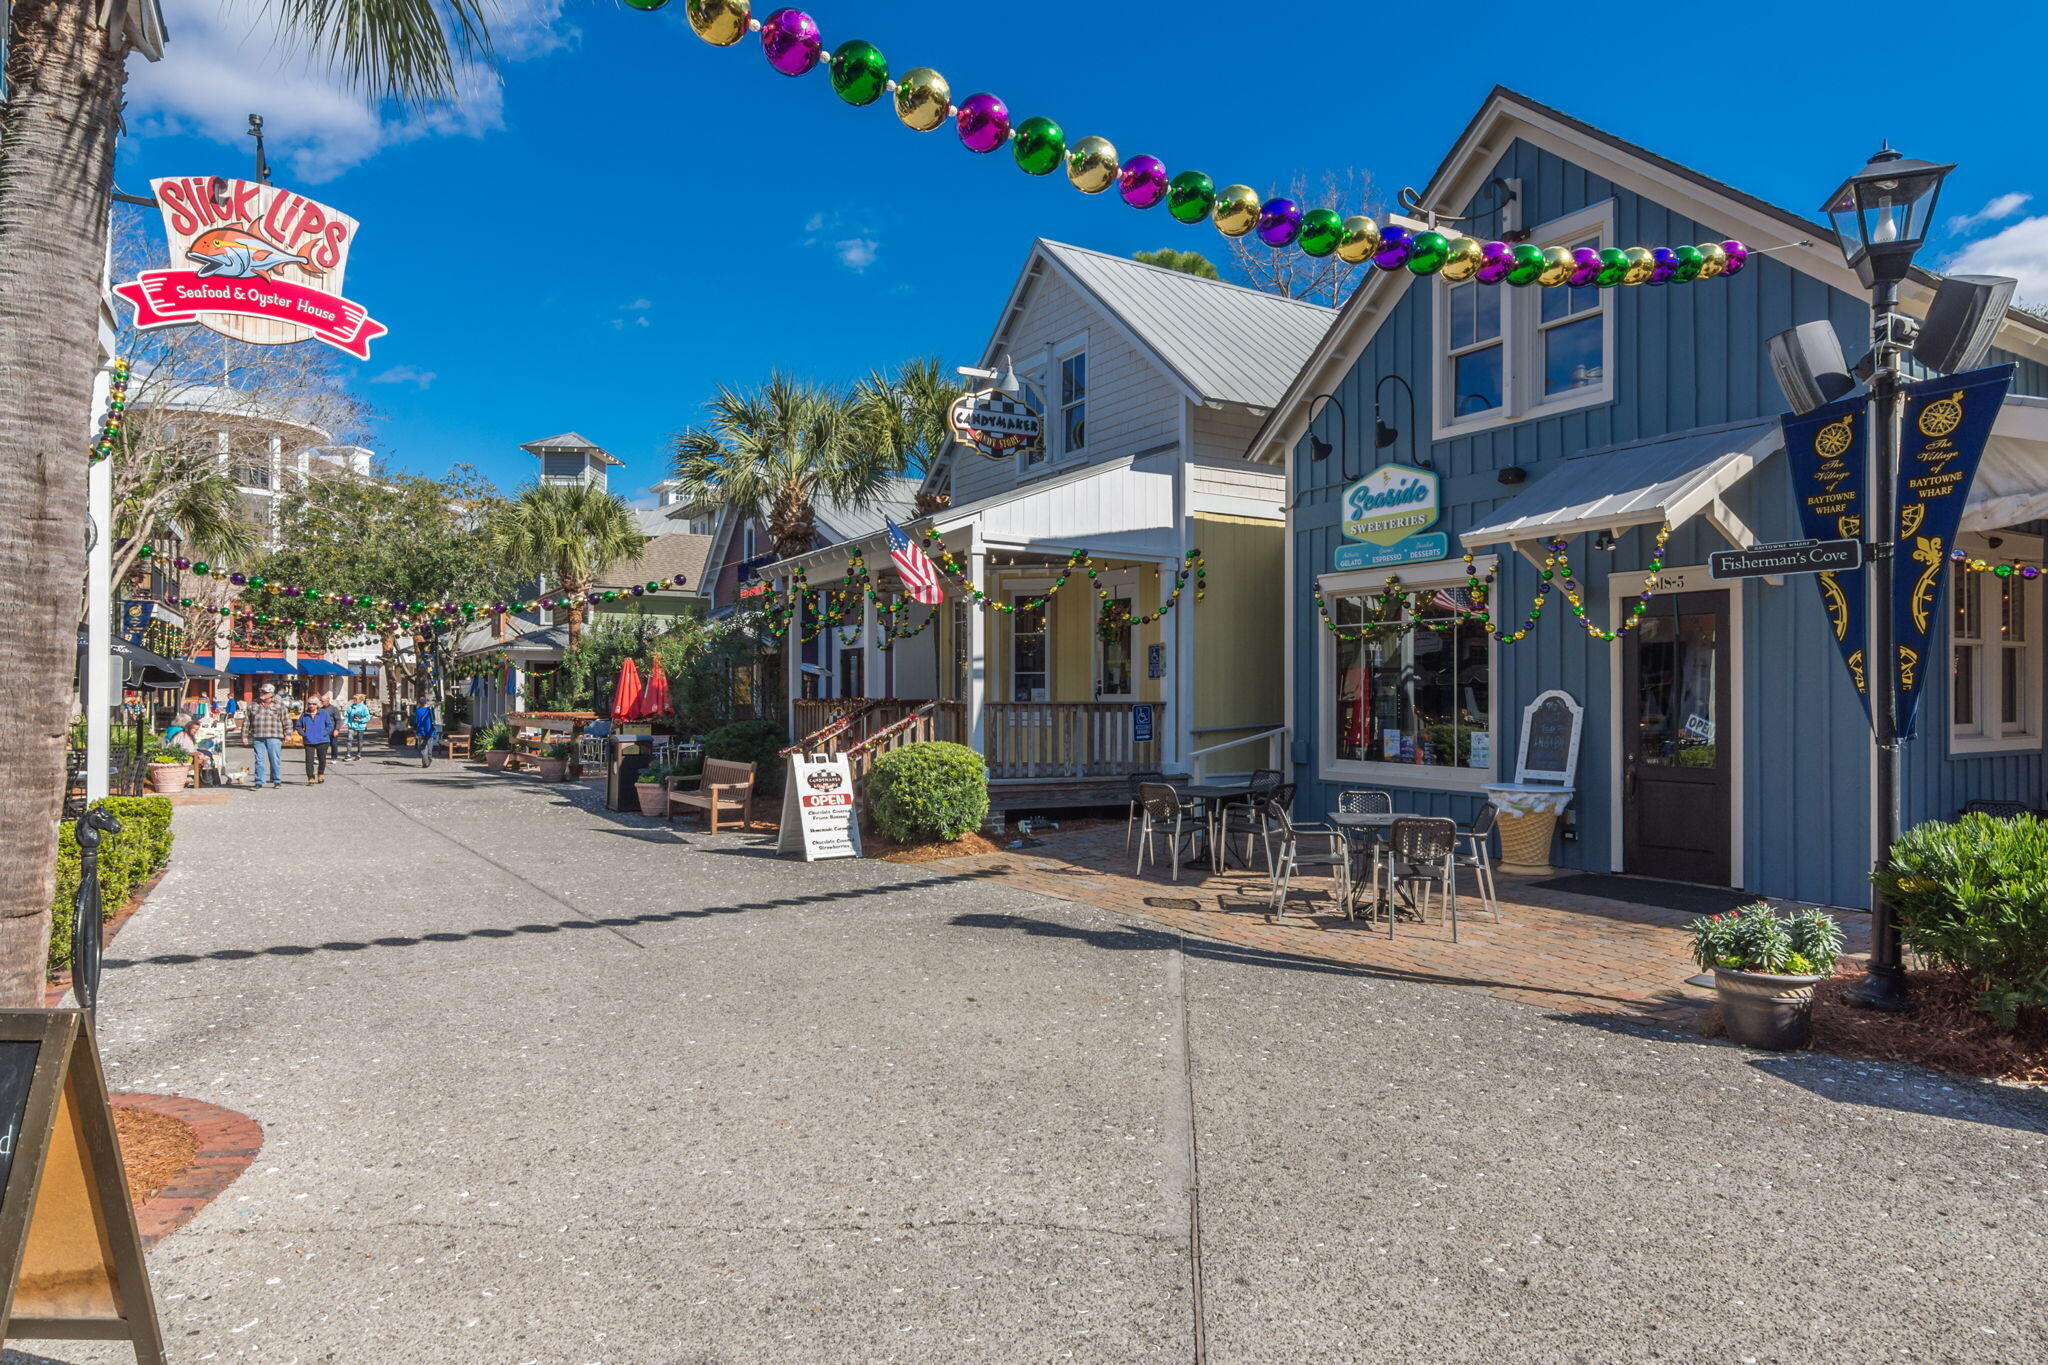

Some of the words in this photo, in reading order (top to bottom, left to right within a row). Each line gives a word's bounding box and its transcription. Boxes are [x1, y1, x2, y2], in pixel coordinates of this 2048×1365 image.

[176, 284, 231, 299] Seafood
[233, 287, 247, 300] &
[247, 288, 292, 308] Oyster
[297, 298, 336, 322] House
[956, 411, 1038, 432] CANDYMAKER
[1925, 439, 1952, 450] The
[1917, 451, 1959, 461] Village
[1821, 459, 1845, 470] The
[1930, 461, 1946, 474] of
[1814, 472, 1851, 481] Village
[1909, 471, 1963, 488] BAYTOWNE
[1825, 481, 1839, 492] of
[1919, 485, 1953, 498] WHARF
[1348, 478, 1428, 521] Seaside
[1807, 491, 1856, 505] BAYTOWNE
[1815, 504, 1847, 515] WHARF
[1350, 514, 1427, 536] SWEETERIES
[1340, 558, 1362, 567] GELATO
[1372, 553, 1402, 564] ESPRESSO
[1410, 548, 1441, 559] DESSERTS
[1720, 552, 1807, 571] Fisherman's
[1809, 548, 1848, 563] Cove
[810, 794, 846, 806] OPEN
